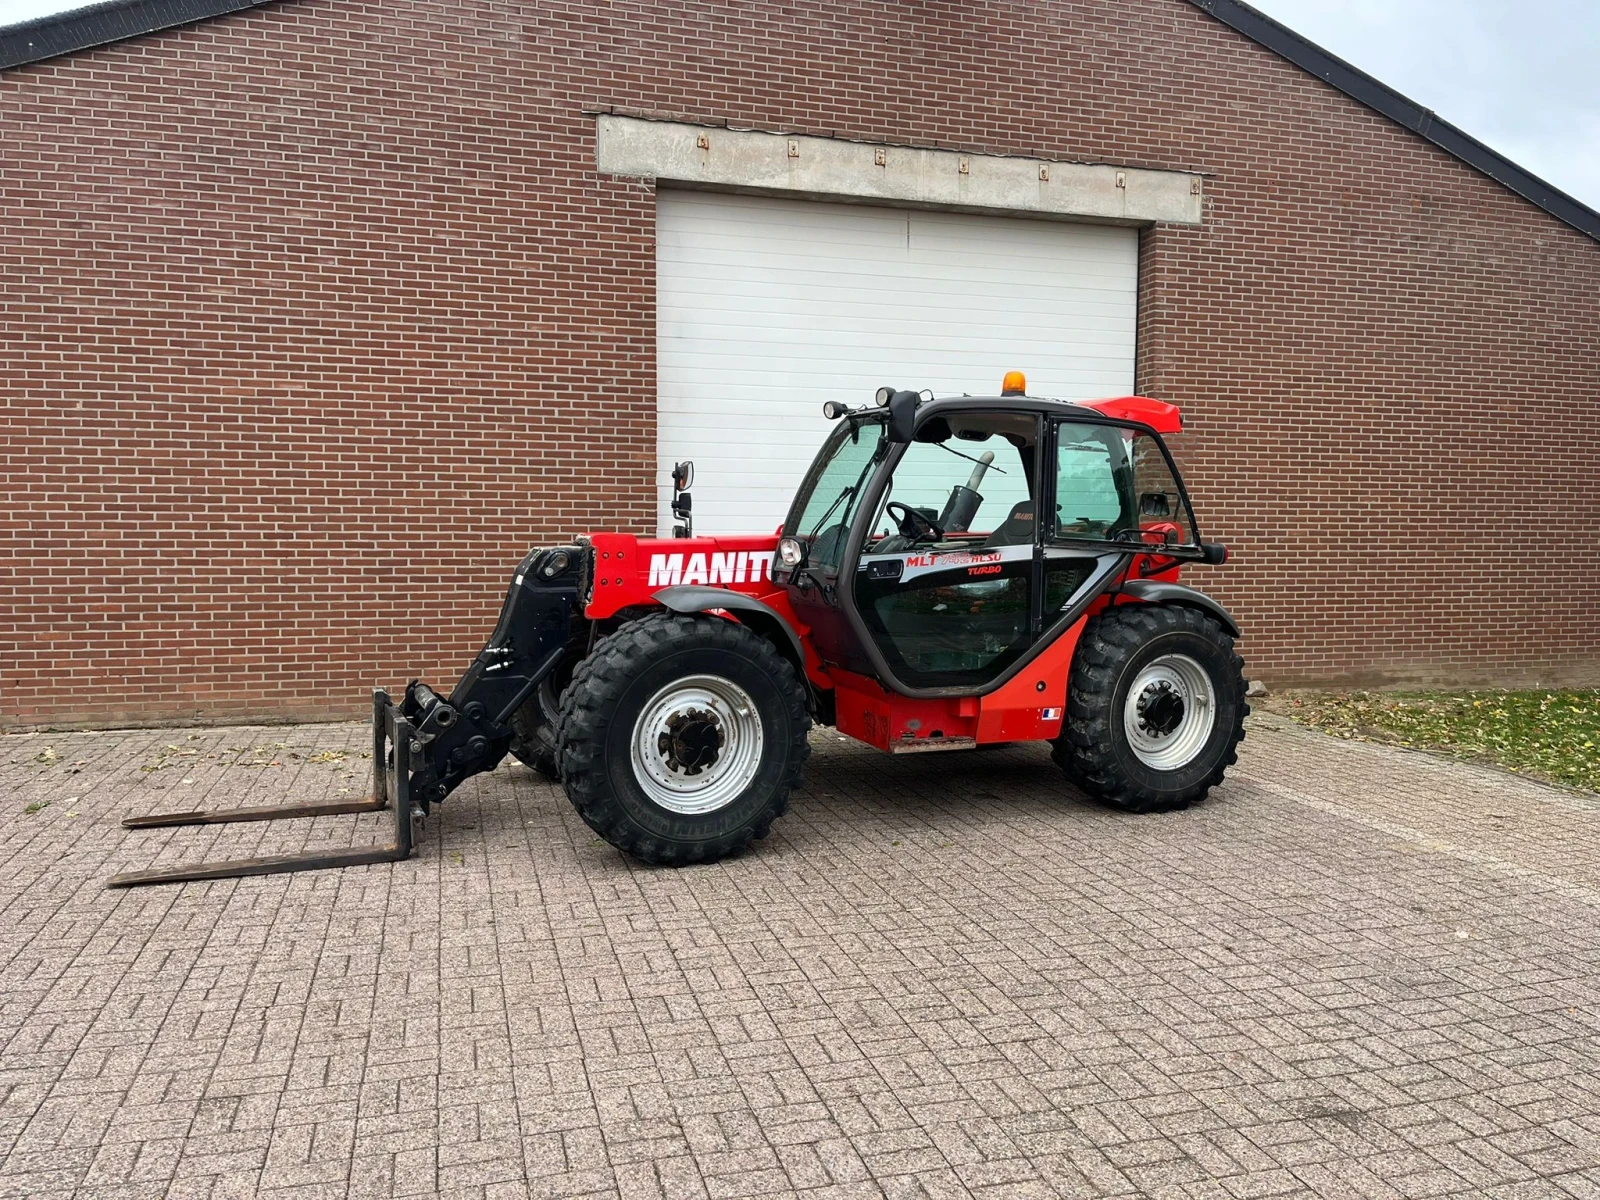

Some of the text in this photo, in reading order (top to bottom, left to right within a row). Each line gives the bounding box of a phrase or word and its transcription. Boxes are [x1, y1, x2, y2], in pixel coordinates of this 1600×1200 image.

[906, 556, 939, 568] MLT
[648, 551, 772, 586] MANIT
[968, 565, 1002, 575] TURBO
